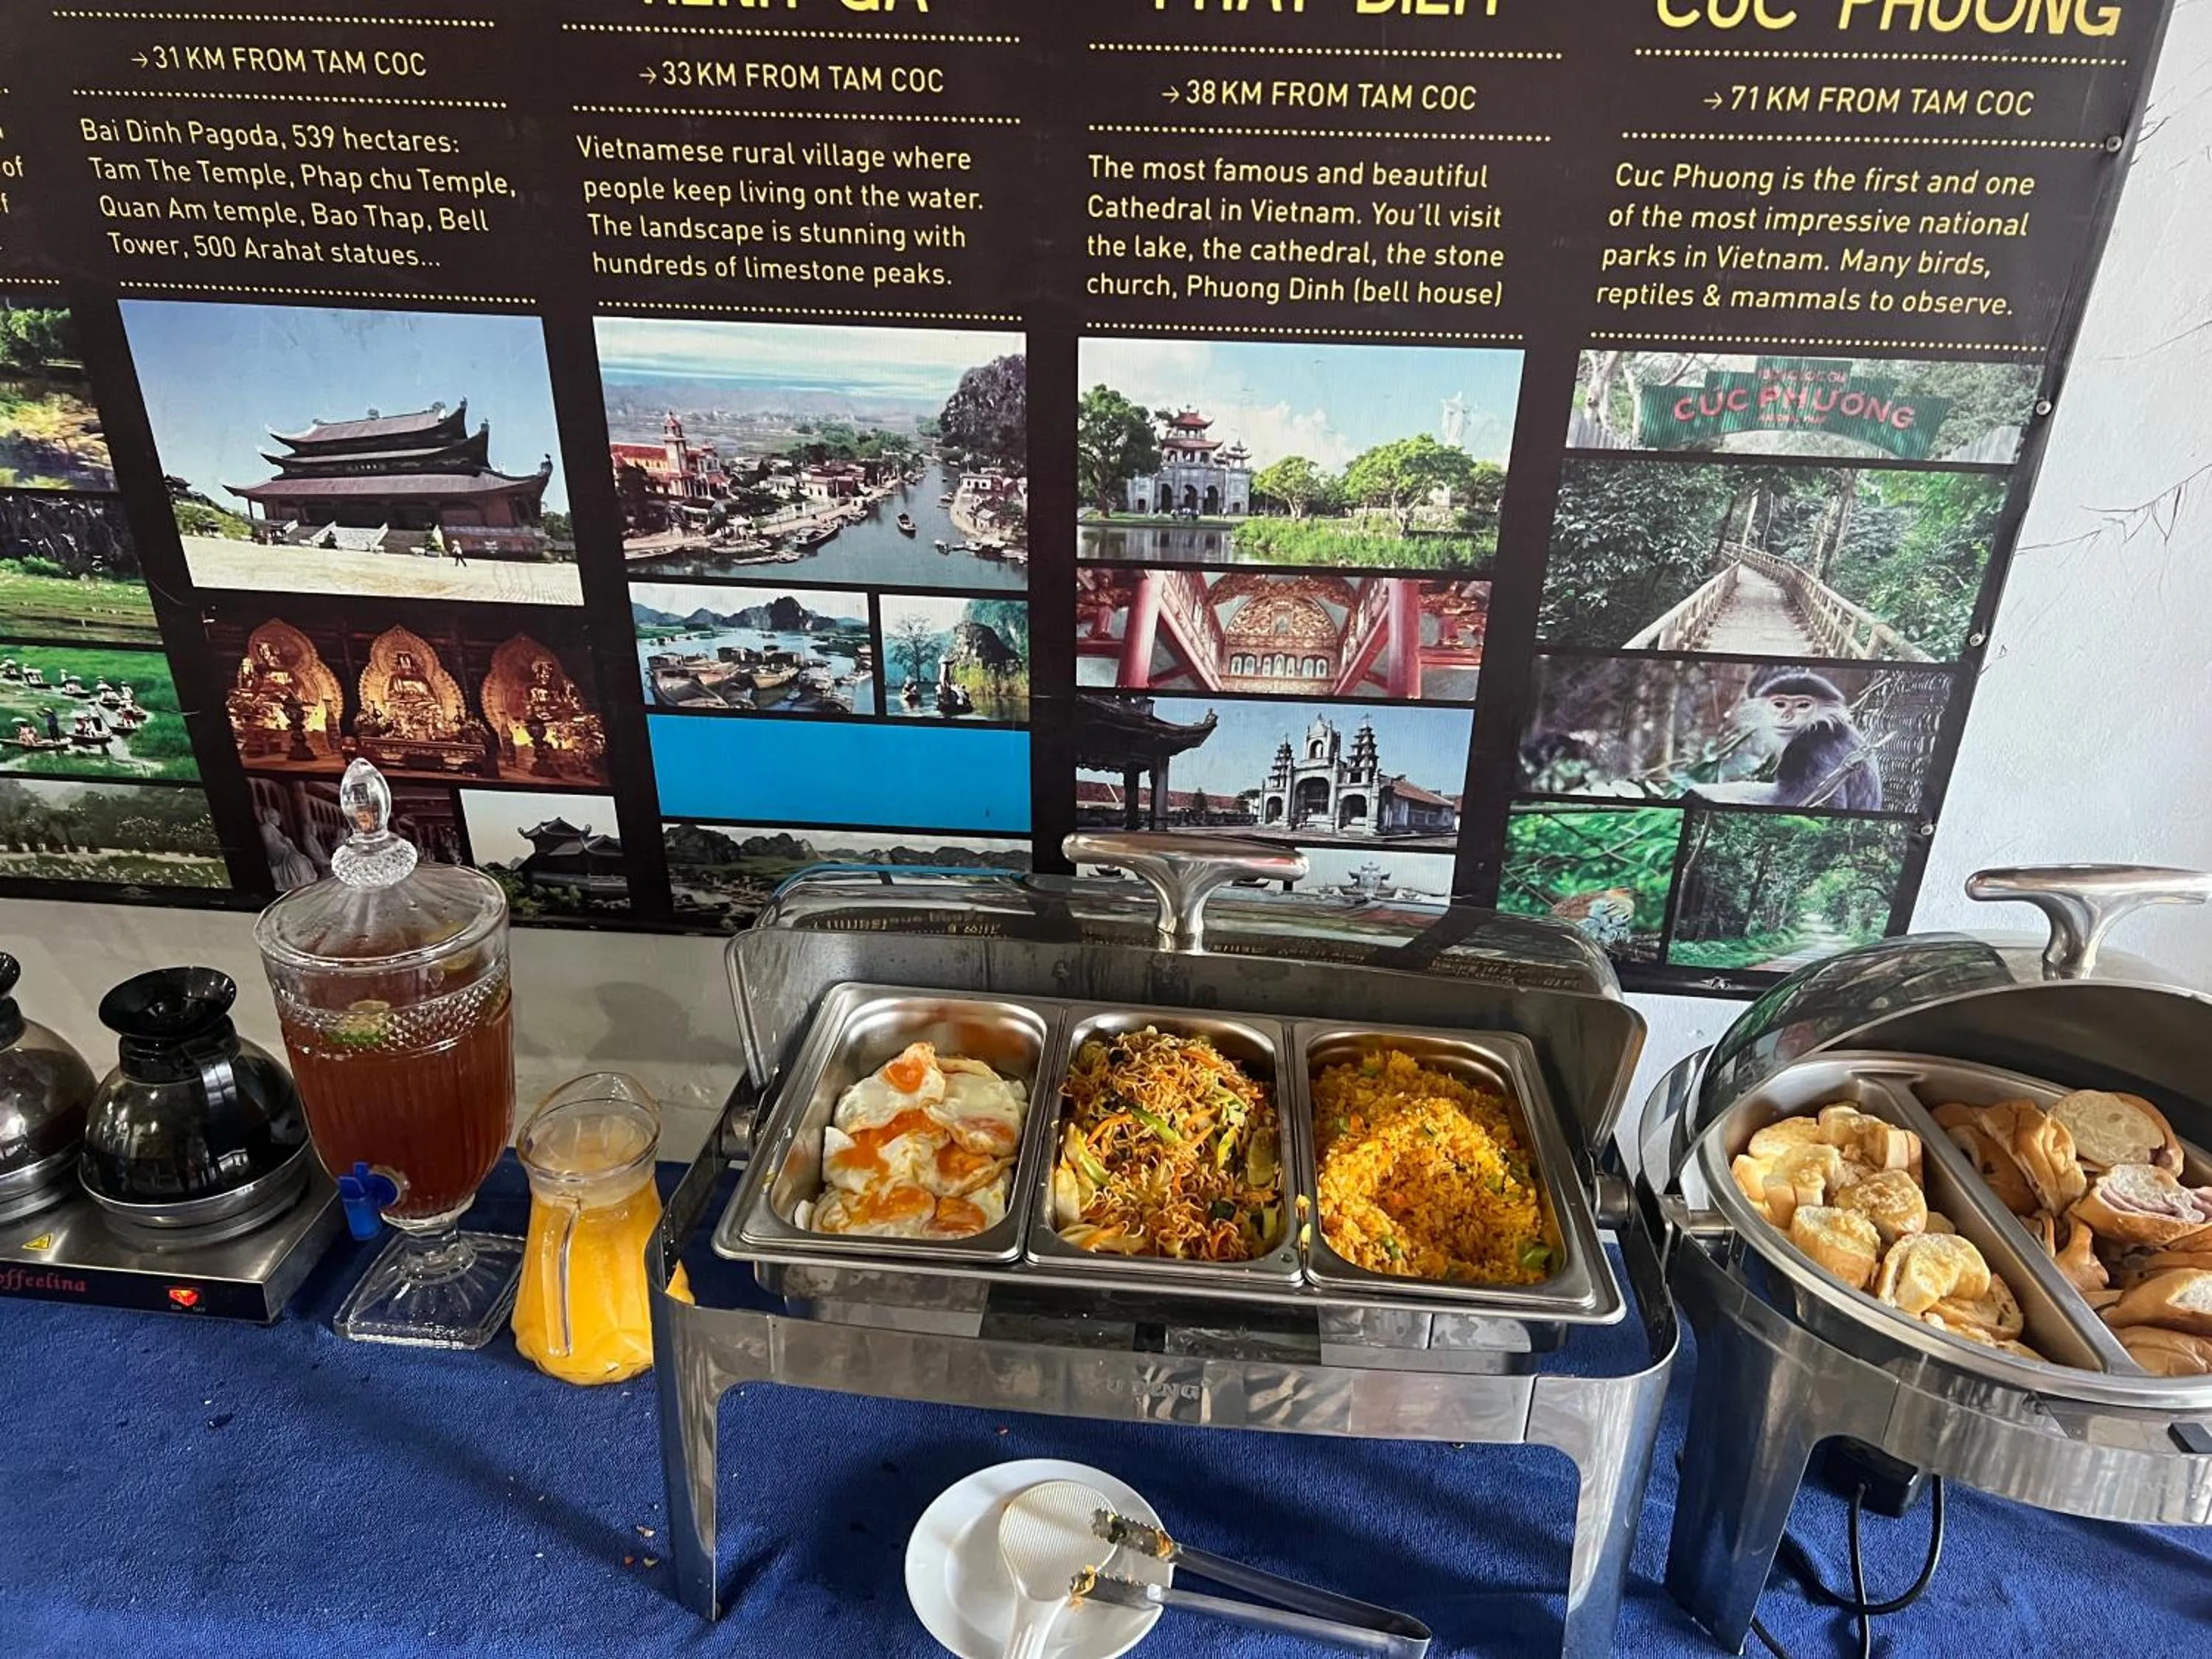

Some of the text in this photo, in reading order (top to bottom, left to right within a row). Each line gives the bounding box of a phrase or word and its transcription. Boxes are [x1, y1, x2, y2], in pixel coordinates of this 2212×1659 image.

[153, 45, 426, 76] 31 KM FROM TAM COC
[662, 60, 944, 93] 33 KM FROM TAM COC
[1186, 79, 1477, 111] 38 KM FROM TAM COC
[1731, 85, 2035, 116] 71 KM FROM TAM COC
[80, 118, 459, 153] Bai Dinh Pagoda, 539 hectares:
[2, 155, 24, 178] of
[576, 135, 971, 173] Vietnamese rural village where
[1088, 154, 1487, 188] The most famous and beautiful
[88, 156, 516, 198] Tam The Temple, Phap chu Temple,
[583, 176, 983, 210] people keep living ont the water.
[1615, 162, 2036, 196] Cuc Phuong is the first and one
[100, 195, 489, 234] Quan Am temple, Bao Thap, Bell
[1088, 194, 1502, 229] Cathedral in Vietnam. You'll visit
[1608, 203, 2030, 237] of the most impressive national
[587, 213, 965, 251] The landscape is stunning with
[106, 232, 440, 267] Tower, 500 Arahat statues...
[1088, 233, 1504, 267] the lake, the cathedral, the stone
[1601, 243, 1991, 279] parks in Vietnam. Many birds,
[592, 251, 952, 288] hundreds of limestone peaks.
[1087, 272, 1503, 307] church, Phuong Dinh (bell house)
[1596, 282, 2013, 316] reptiles & mammals to observe.
